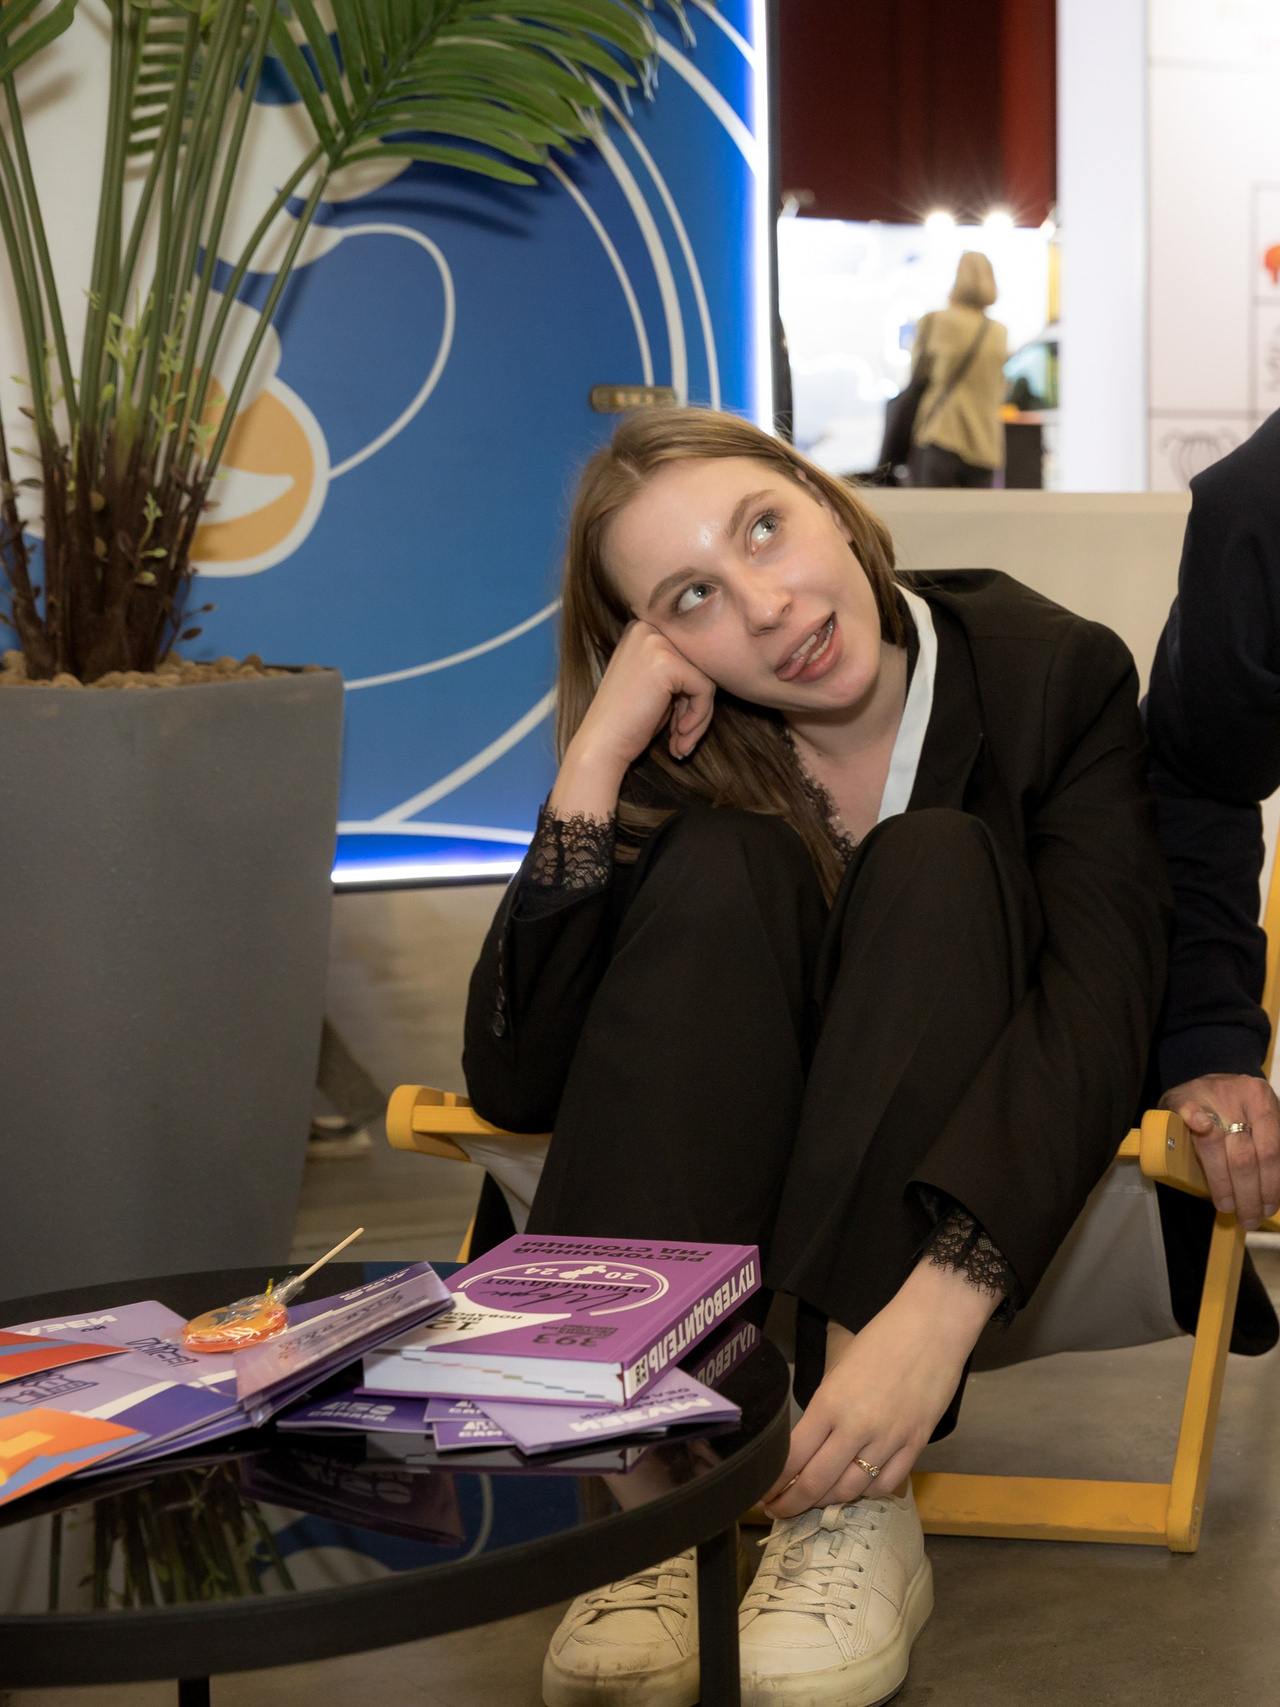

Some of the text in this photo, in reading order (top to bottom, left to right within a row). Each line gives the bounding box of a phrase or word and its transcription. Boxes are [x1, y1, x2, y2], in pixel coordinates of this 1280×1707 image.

[512, 1247, 706, 1263] РЕСТОРАННЫЙ
[520, 1241, 713, 1257] ГИД СТОЛИЦЫ
[522, 1267, 639, 1281] 20 24
[481, 1278, 649, 1294] РЕКОМЕНДУЮТ
[649, 1260, 756, 1374] ПУТЕВОДИТЕЛЬ
[14, 1314, 118, 1337] УЗЕИ
[531, 1333, 599, 1348] 393
[570, 1397, 713, 1433] МУЗЕИ
[458, 1430, 503, 1438] САМ
